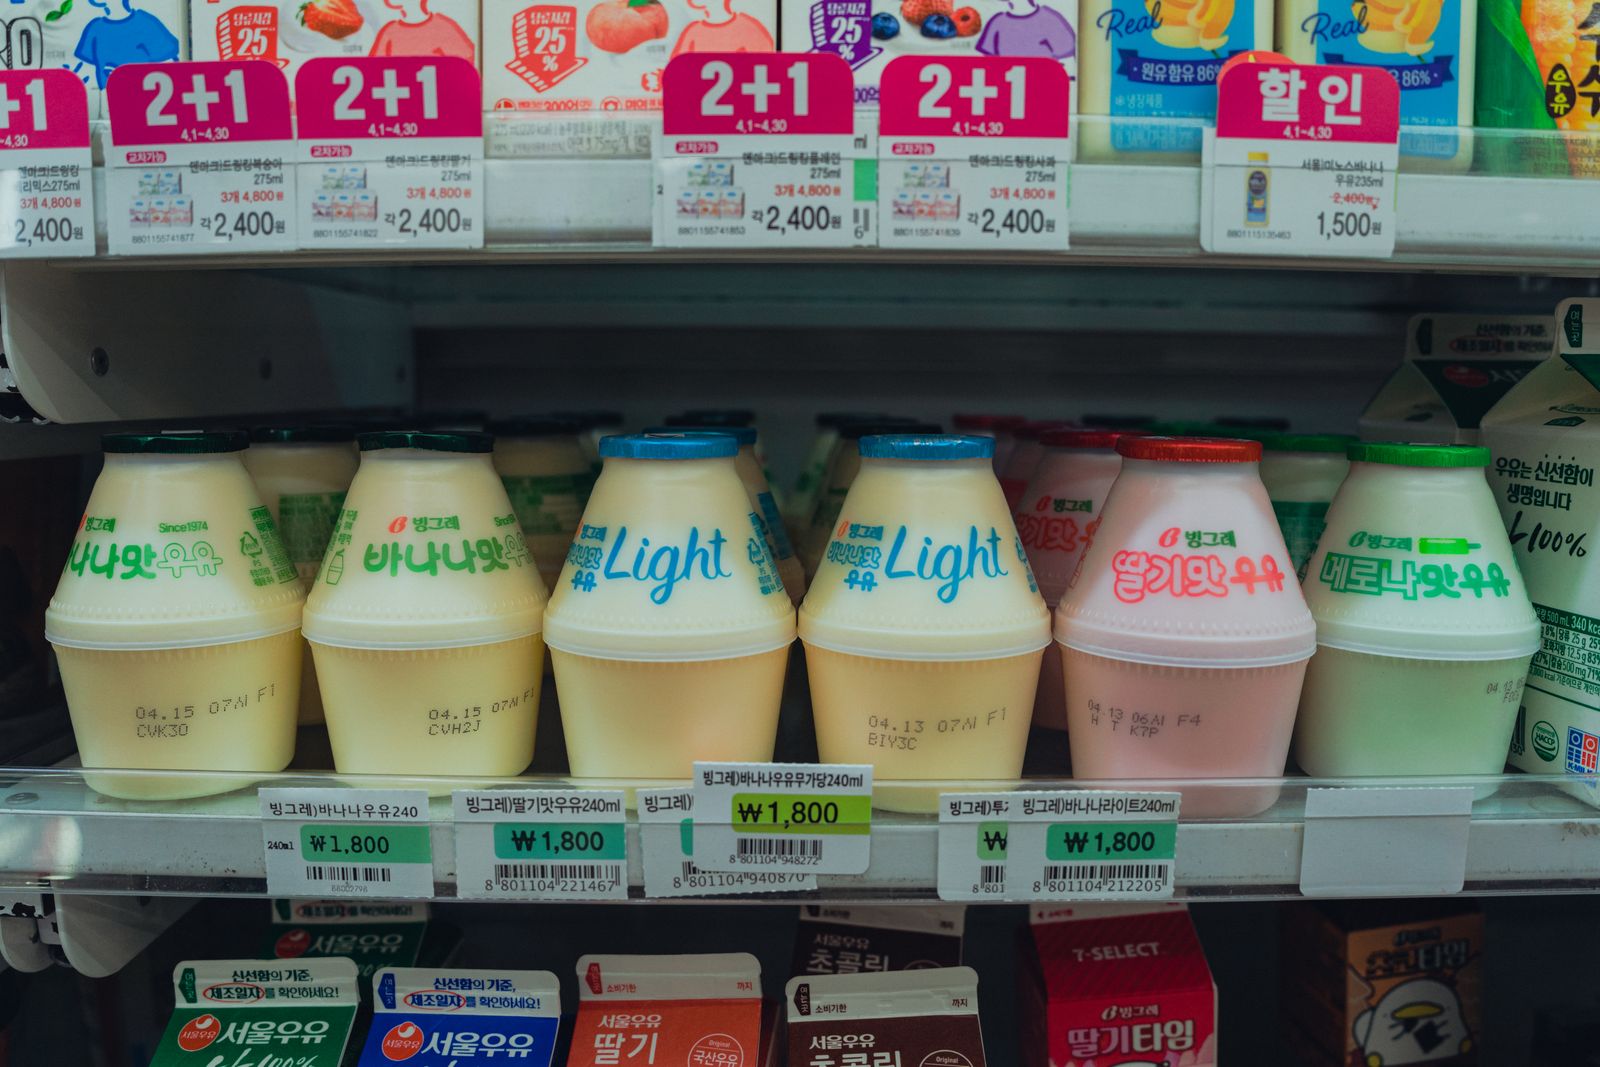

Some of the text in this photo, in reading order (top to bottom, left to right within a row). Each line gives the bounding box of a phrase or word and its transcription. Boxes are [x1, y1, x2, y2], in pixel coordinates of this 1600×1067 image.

[1096, 0, 1163, 41] Real
[1301, 5, 1369, 45] Real
[830, 17, 864, 44] 25
[237, 28, 268, 56] 25
[534, 27, 567, 55] 25
[1142, 63, 1194, 82] 원유함유
[1402, 71, 1431, 87] 86%
[332, 65, 439, 121] 2+1
[700, 60, 809, 116] 2+1
[919, 64, 1026, 119] 2+1
[1548, 69, 1571, 116] 우유
[142, 69, 249, 127] 2+1
[254, 173, 284, 186] 275ml
[441, 170, 472, 182] 275ml
[810, 168, 842, 179] 275ml
[1025, 171, 1056, 183] 275ml
[1335, 174, 1384, 188] 우유235ml
[1317, 211, 1382, 241] 1,500원
[1496, 457, 1594, 487] 우유는 신선함이
[1506, 484, 1573, 511] 생명입니다
[85, 516, 118, 534] 빙그레
[412, 515, 461, 534] 빙그레
[849, 523, 884, 541] 빙그레
[1185, 530, 1238, 550] 빙그레
[1367, 535, 1413, 553] 빙그레
[604, 526, 733, 605] Light
[885, 525, 1010, 604] Light
[571, 570, 597, 592] 우유
[844, 569, 879, 592] 우유
[1571, 615, 1587, 632] 340
[703, 774, 863, 789] 빙그레)바나나우유무가당240ml
[269, 802, 418, 819] 빙그레)바나나우유240
[466, 796, 621, 814] 빙그레)딸기맛우유240ml
[1023, 798, 1175, 815] 빙그레)바나나라이트240ml
[267, 841, 295, 851] 240ml
[501, 879, 555, 892] 801104
[560, 880, 616, 892] 221467
[689, 869, 744, 887] 801104
[1048, 880, 1103, 893] 801104
[1107, 880, 1162, 892] 212205
[1072, 942, 1160, 962] 7-SELECT
[232, 969, 314, 984] 신선함의 기준,
[433, 977, 516, 993] 신선함의 기준,
[278, 986, 340, 1000] 확인하세요!
[606, 984, 637, 994] 소비기한
[479, 996, 541, 1010] 확인하세요!
[815, 998, 968, 1014] 소비기한 까지
[597, 1014, 662, 1029] 서울우유
[216, 1020, 330, 1045] 서울우유
[810, 1033, 876, 1050] 서울우유
[1067, 1020, 1196, 1058] 딸기타임
[420, 1031, 535, 1058] 서울우유
[593, 1033, 658, 1065] 딸기
